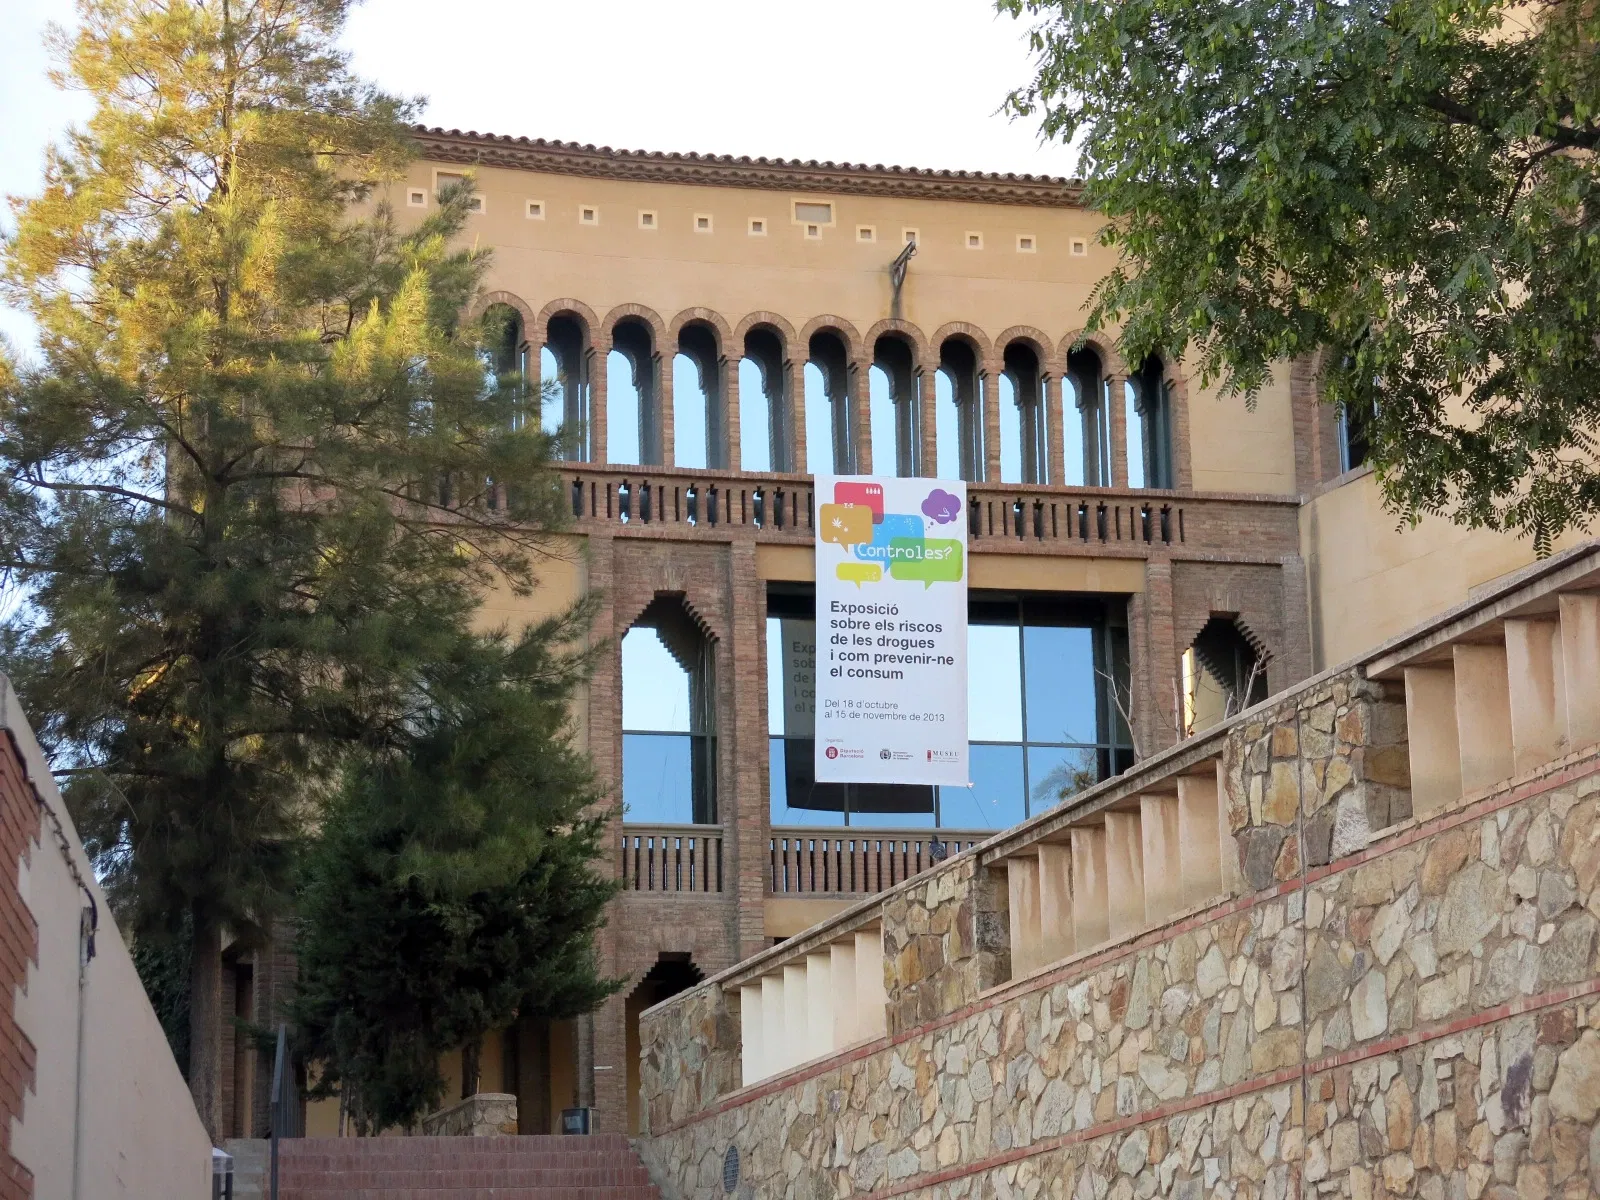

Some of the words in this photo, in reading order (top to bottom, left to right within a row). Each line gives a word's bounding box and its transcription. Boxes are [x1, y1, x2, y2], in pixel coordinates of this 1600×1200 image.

[857, 543, 952, 560] Controles?
[830, 601, 899, 616] Exposició
[830, 618, 871, 630] sobre
[874, 619, 895, 632] els
[899, 620, 943, 633] riscos
[830, 633, 848, 645] de
[852, 634, 872, 646] les
[877, 635, 935, 651] drogues
[830, 649, 834, 661] i
[838, 651, 870, 662] com
[874, 652, 954, 669] prevenir-ne
[830, 666, 842, 678] el
[846, 667, 903, 680] consum
[824, 699, 840, 708] Del
[843, 700, 854, 708] 18
[856, 700, 899, 709] d'octubre
[824, 710, 832, 718] al
[836, 710, 846, 719] 15
[849, 711, 861, 719] de
[863, 712, 907, 721] novembre
[909, 713, 921, 721] de
[923, 713, 945, 722] 2013
